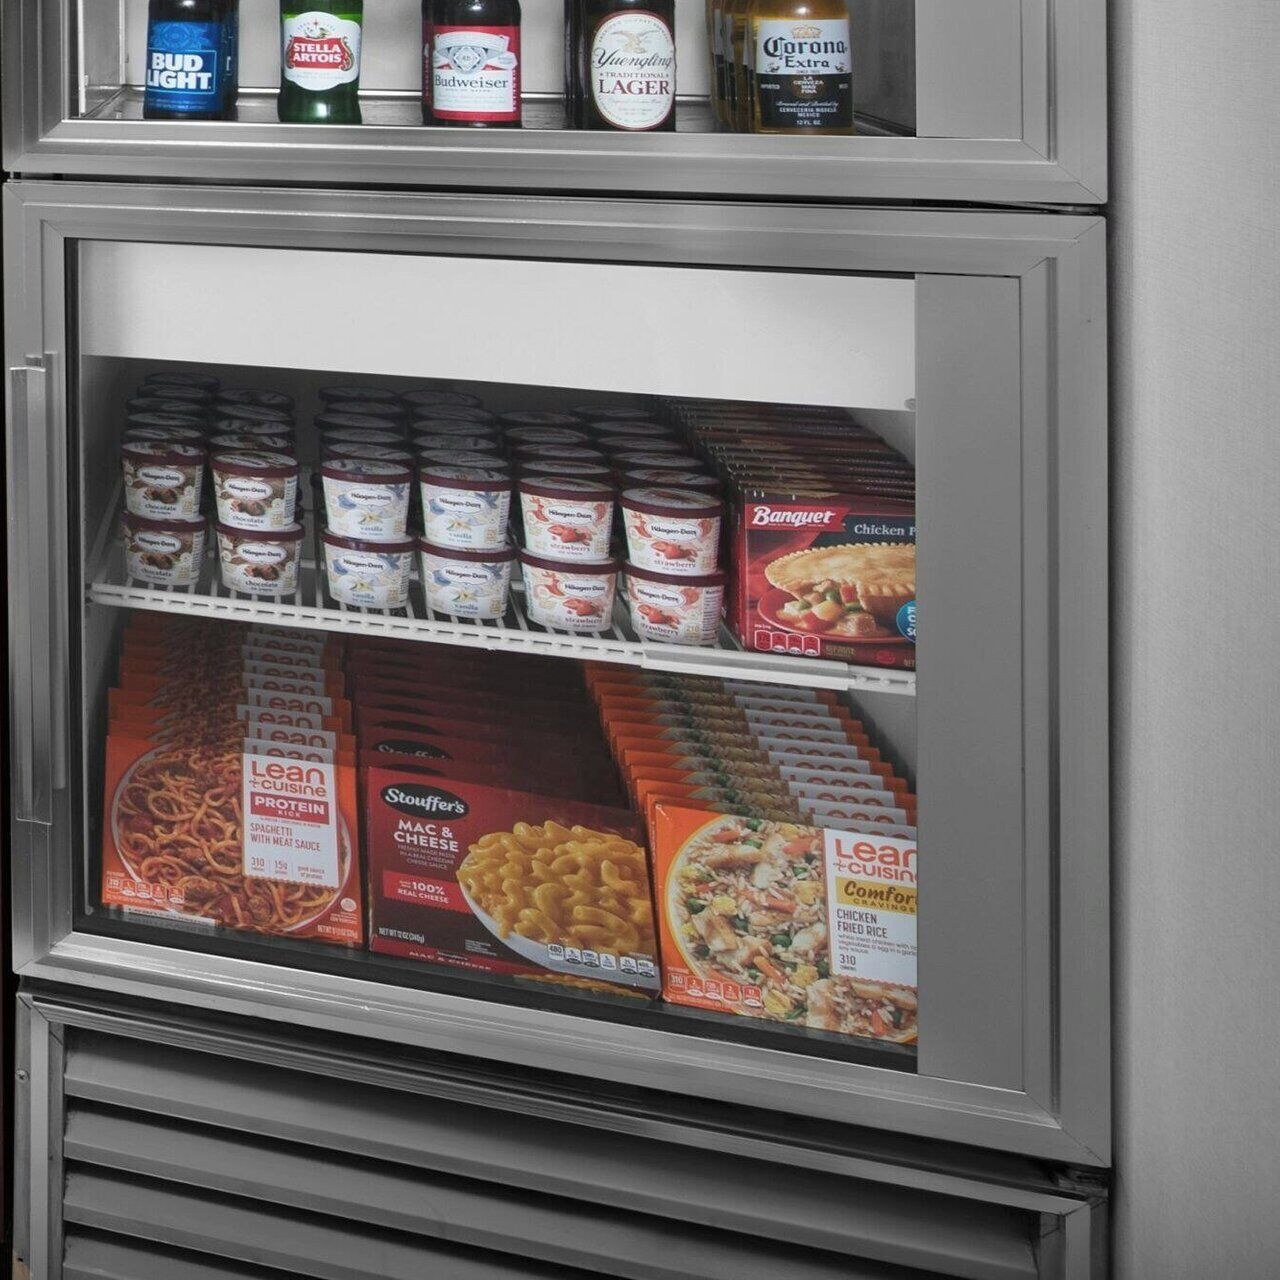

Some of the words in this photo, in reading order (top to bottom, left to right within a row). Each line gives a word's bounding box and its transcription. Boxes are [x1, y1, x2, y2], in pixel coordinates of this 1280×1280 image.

[294, 42, 341, 53] STELLA
[763, 37, 845, 60] Corona
[151, 53, 203, 72] BUD
[293, 51, 343, 63] ARTOIS
[593, 48, 672, 69] Yuengling
[785, 56, 830, 67] Extra
[147, 70, 211, 90] LIGHT
[434, 74, 508, 90] Budweiser
[598, 79, 670, 95] LAGER
[752, 506, 836, 527] Banquet
[854, 524, 905, 535] Chicken
[654, 560, 696, 570] strawberry
[252, 761, 325, 786] Lean
[255, 796, 325, 814] PROTEIN
[385, 788, 465, 814] Stouffer's
[251, 823, 292, 836] SPAGHETTI
[399, 820, 437, 835] MAC
[442, 827, 453, 838] &
[251, 834, 270, 844] WITH
[273, 836, 293, 847] MEAT
[295, 840, 320, 851] SAUCE
[394, 831, 459, 852] CHEESE
[251, 857, 264, 867] 310
[275, 860, 288, 869] 15g
[412, 881, 445, 895] 100%
[844, 880, 916, 904] Comfor
[397, 889, 417, 897] REAL
[419, 892, 449, 904] CHEESE
[854, 899, 916, 913] CRAVINGS
[837, 908, 877, 924] CHICKEN
[838, 921, 864, 935] FRIED
[866, 925, 888, 938] RICE
[840, 954, 856, 966] 310
